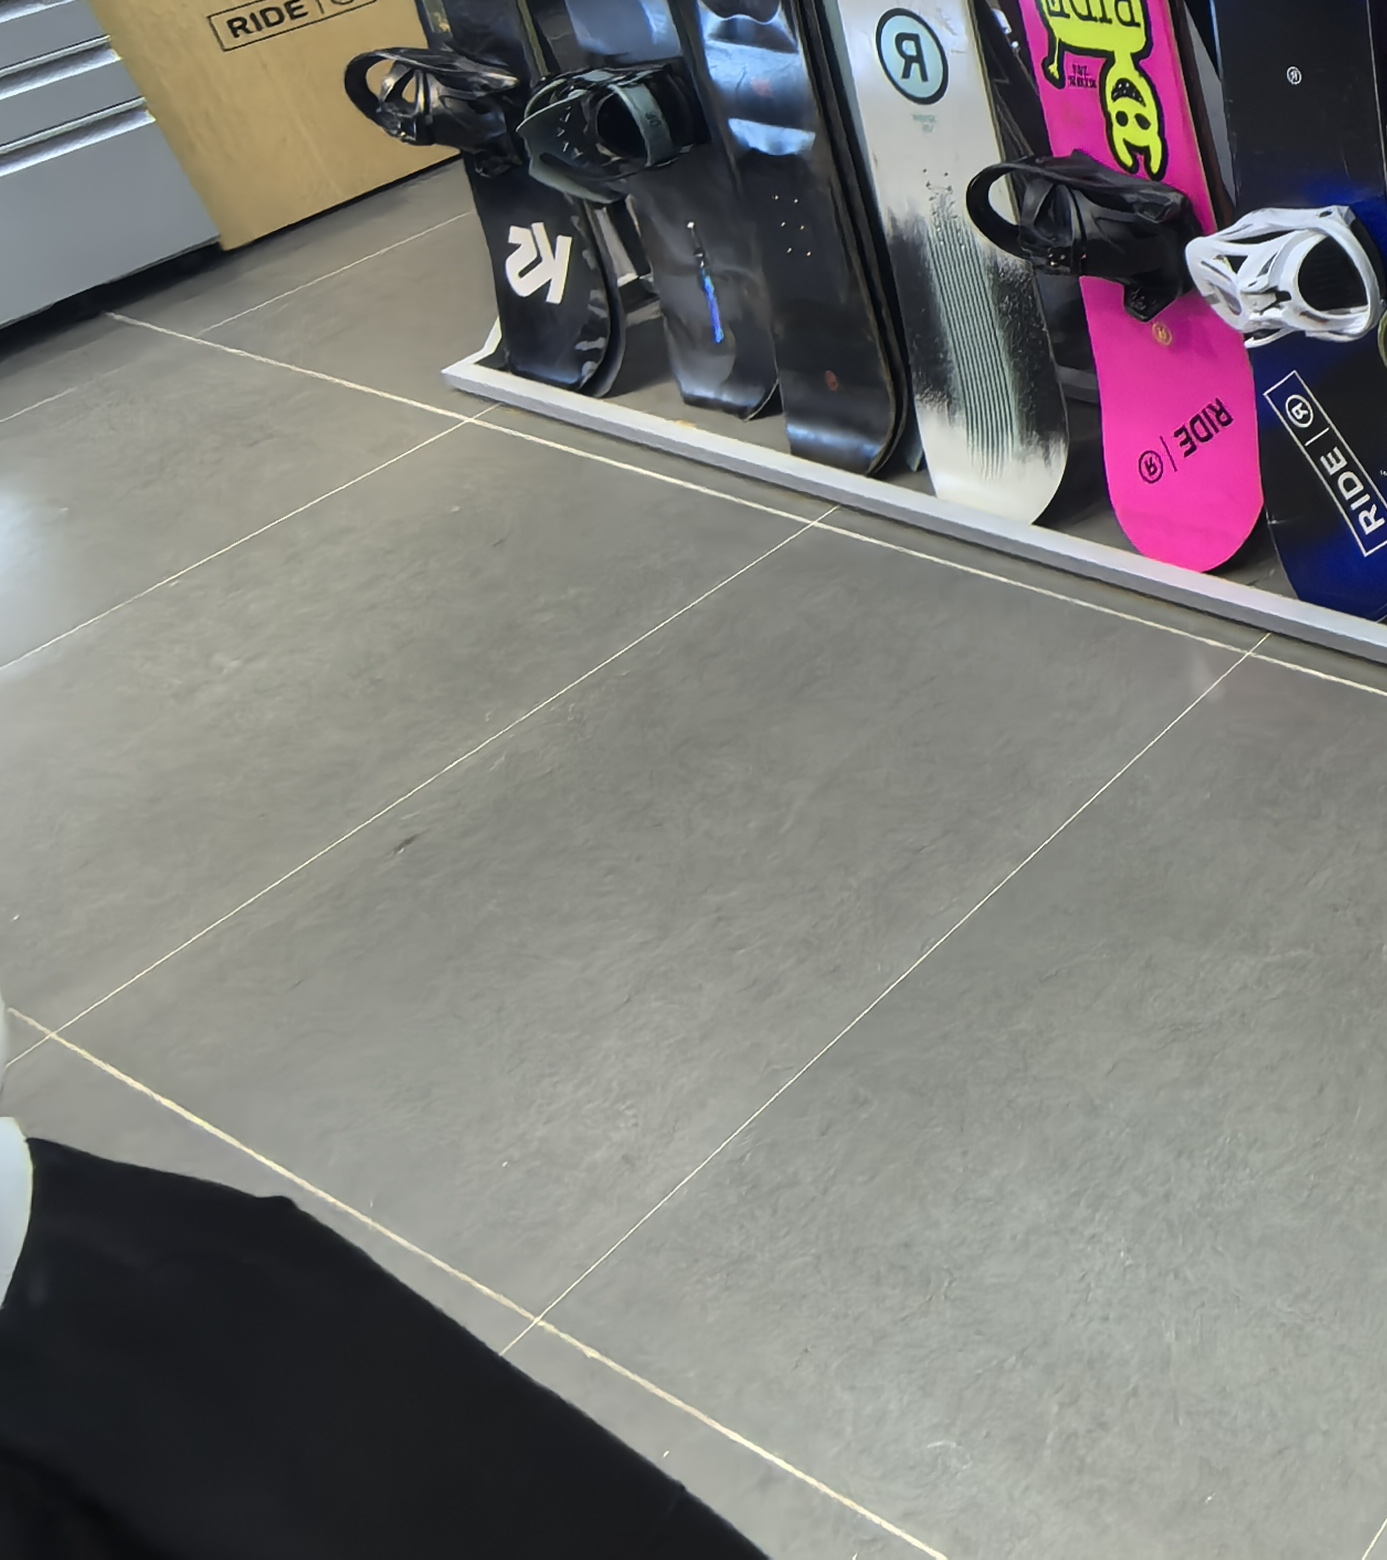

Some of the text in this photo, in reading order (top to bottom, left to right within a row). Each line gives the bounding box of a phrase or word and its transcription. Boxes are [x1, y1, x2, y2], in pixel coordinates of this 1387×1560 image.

[506, 222, 572, 304] K2
[1173, 397, 1234, 458] RIDE
[1323, 452, 1386, 537] RIDE
